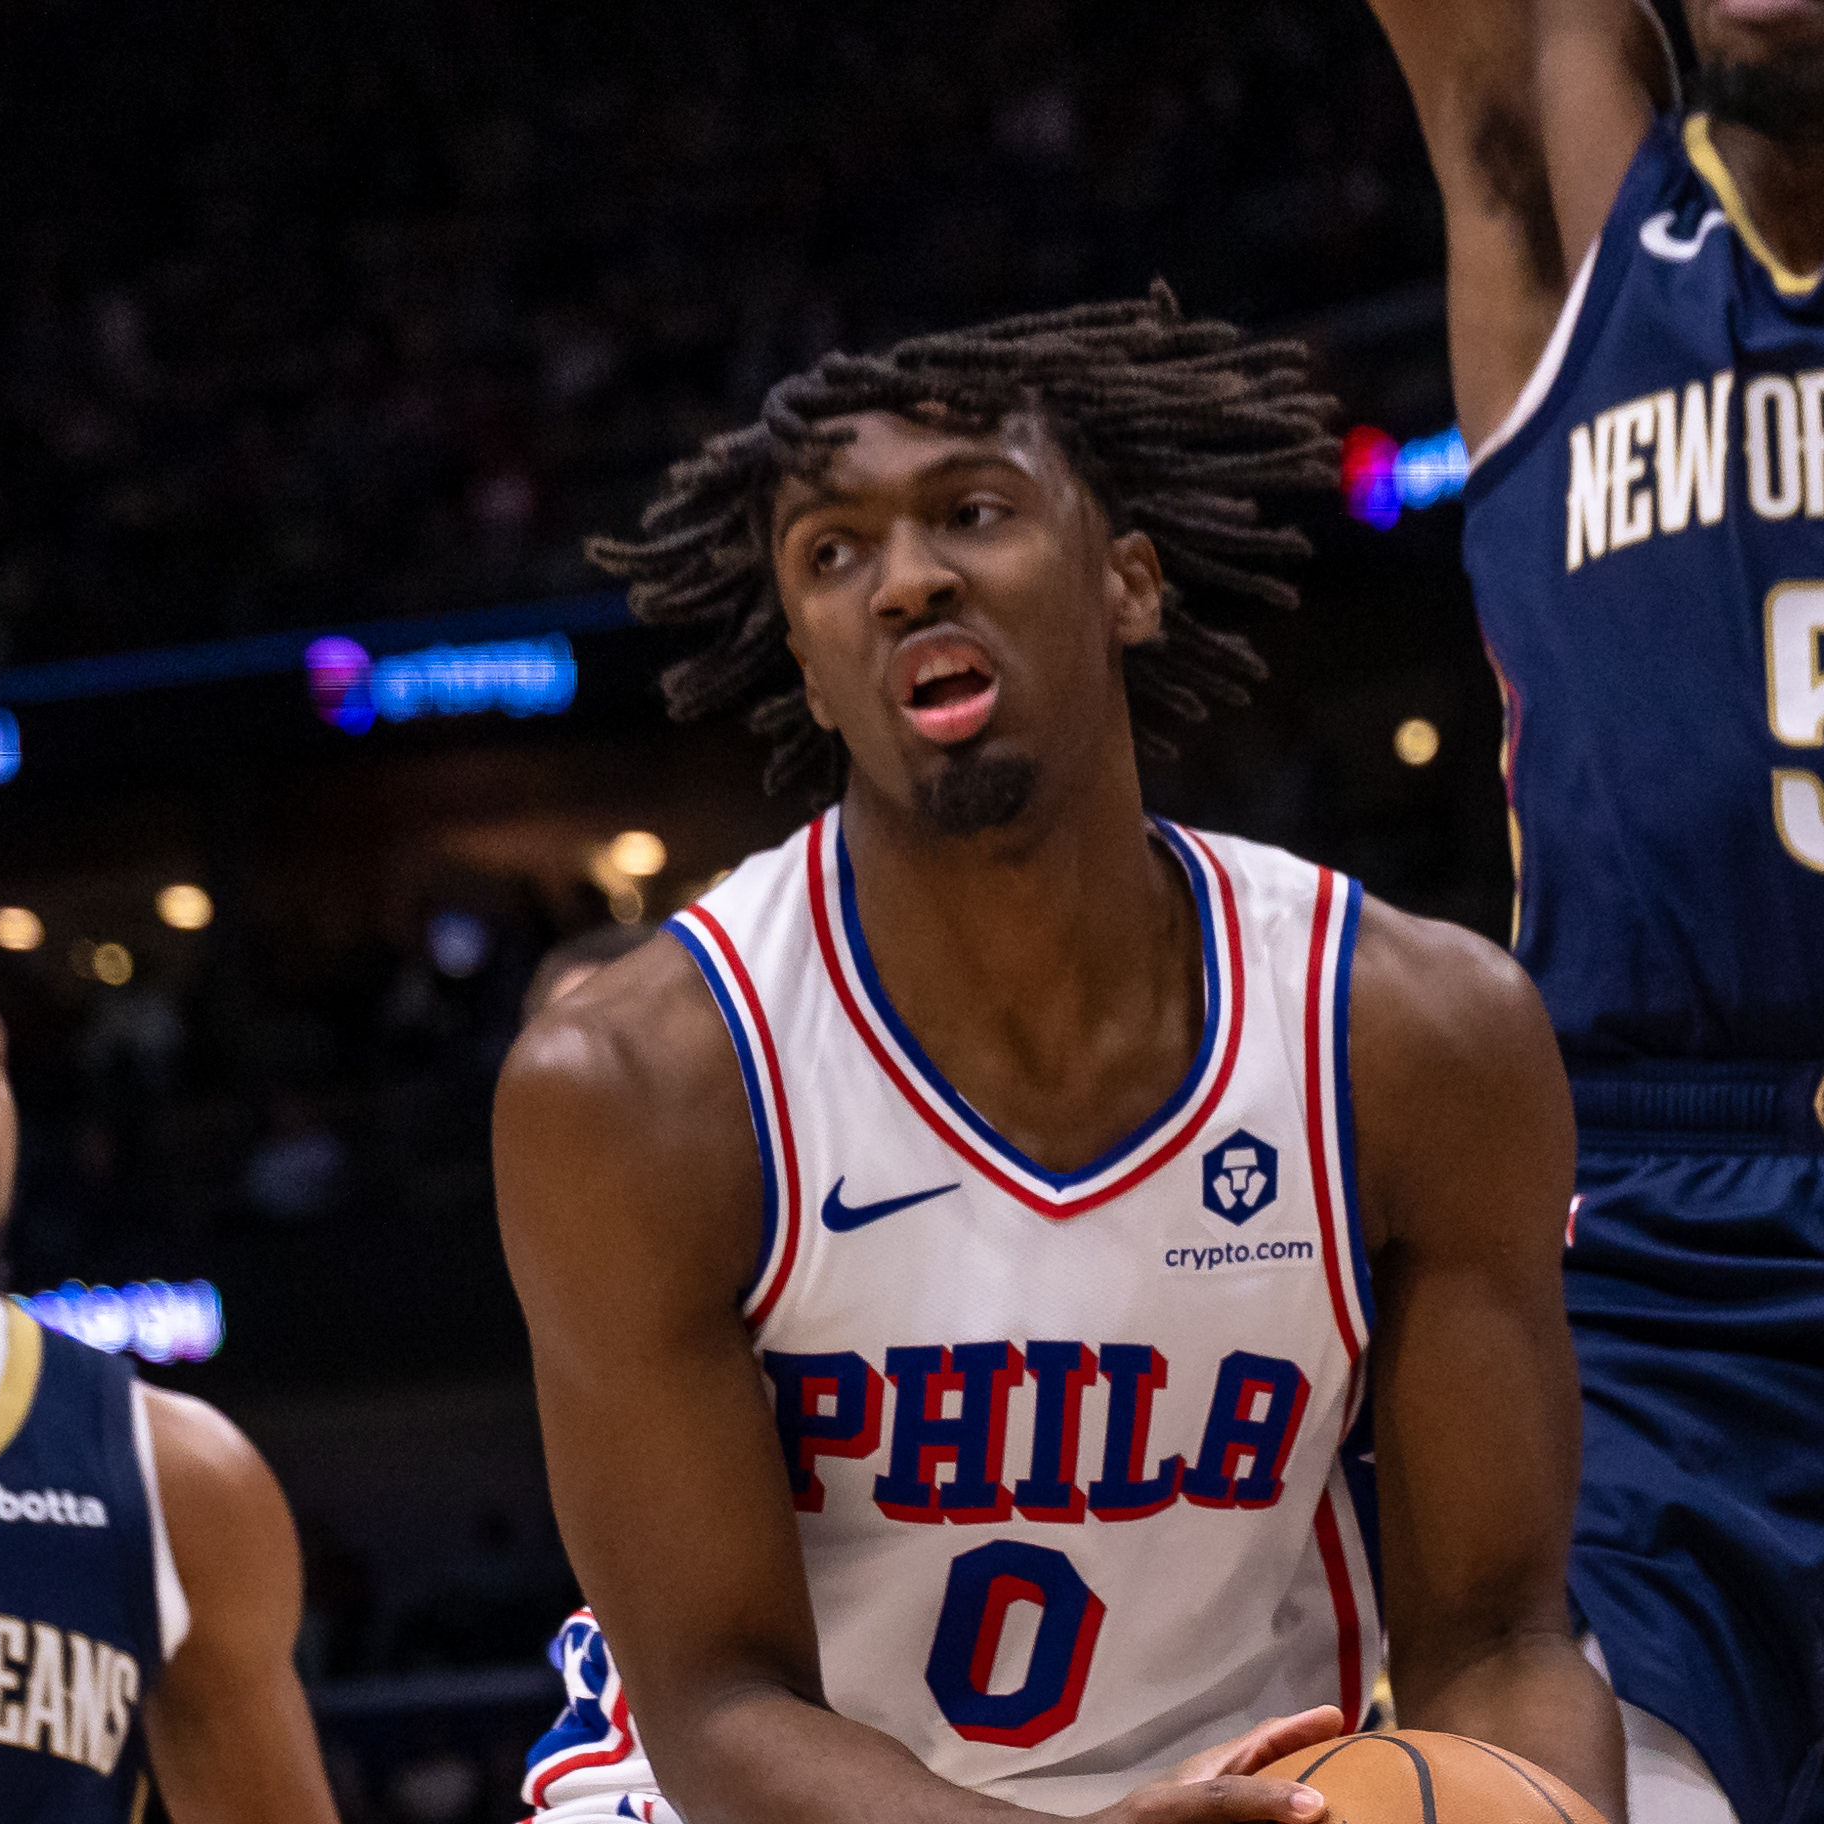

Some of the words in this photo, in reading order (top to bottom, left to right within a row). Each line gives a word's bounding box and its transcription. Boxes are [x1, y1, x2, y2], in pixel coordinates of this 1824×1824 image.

[1565, 371, 1734, 574] NEW
[1165, 1241, 1314, 1270] crypto.com
[763, 1340, 1311, 1524] PHILA
[925, 1540, 1106, 1748] 0
